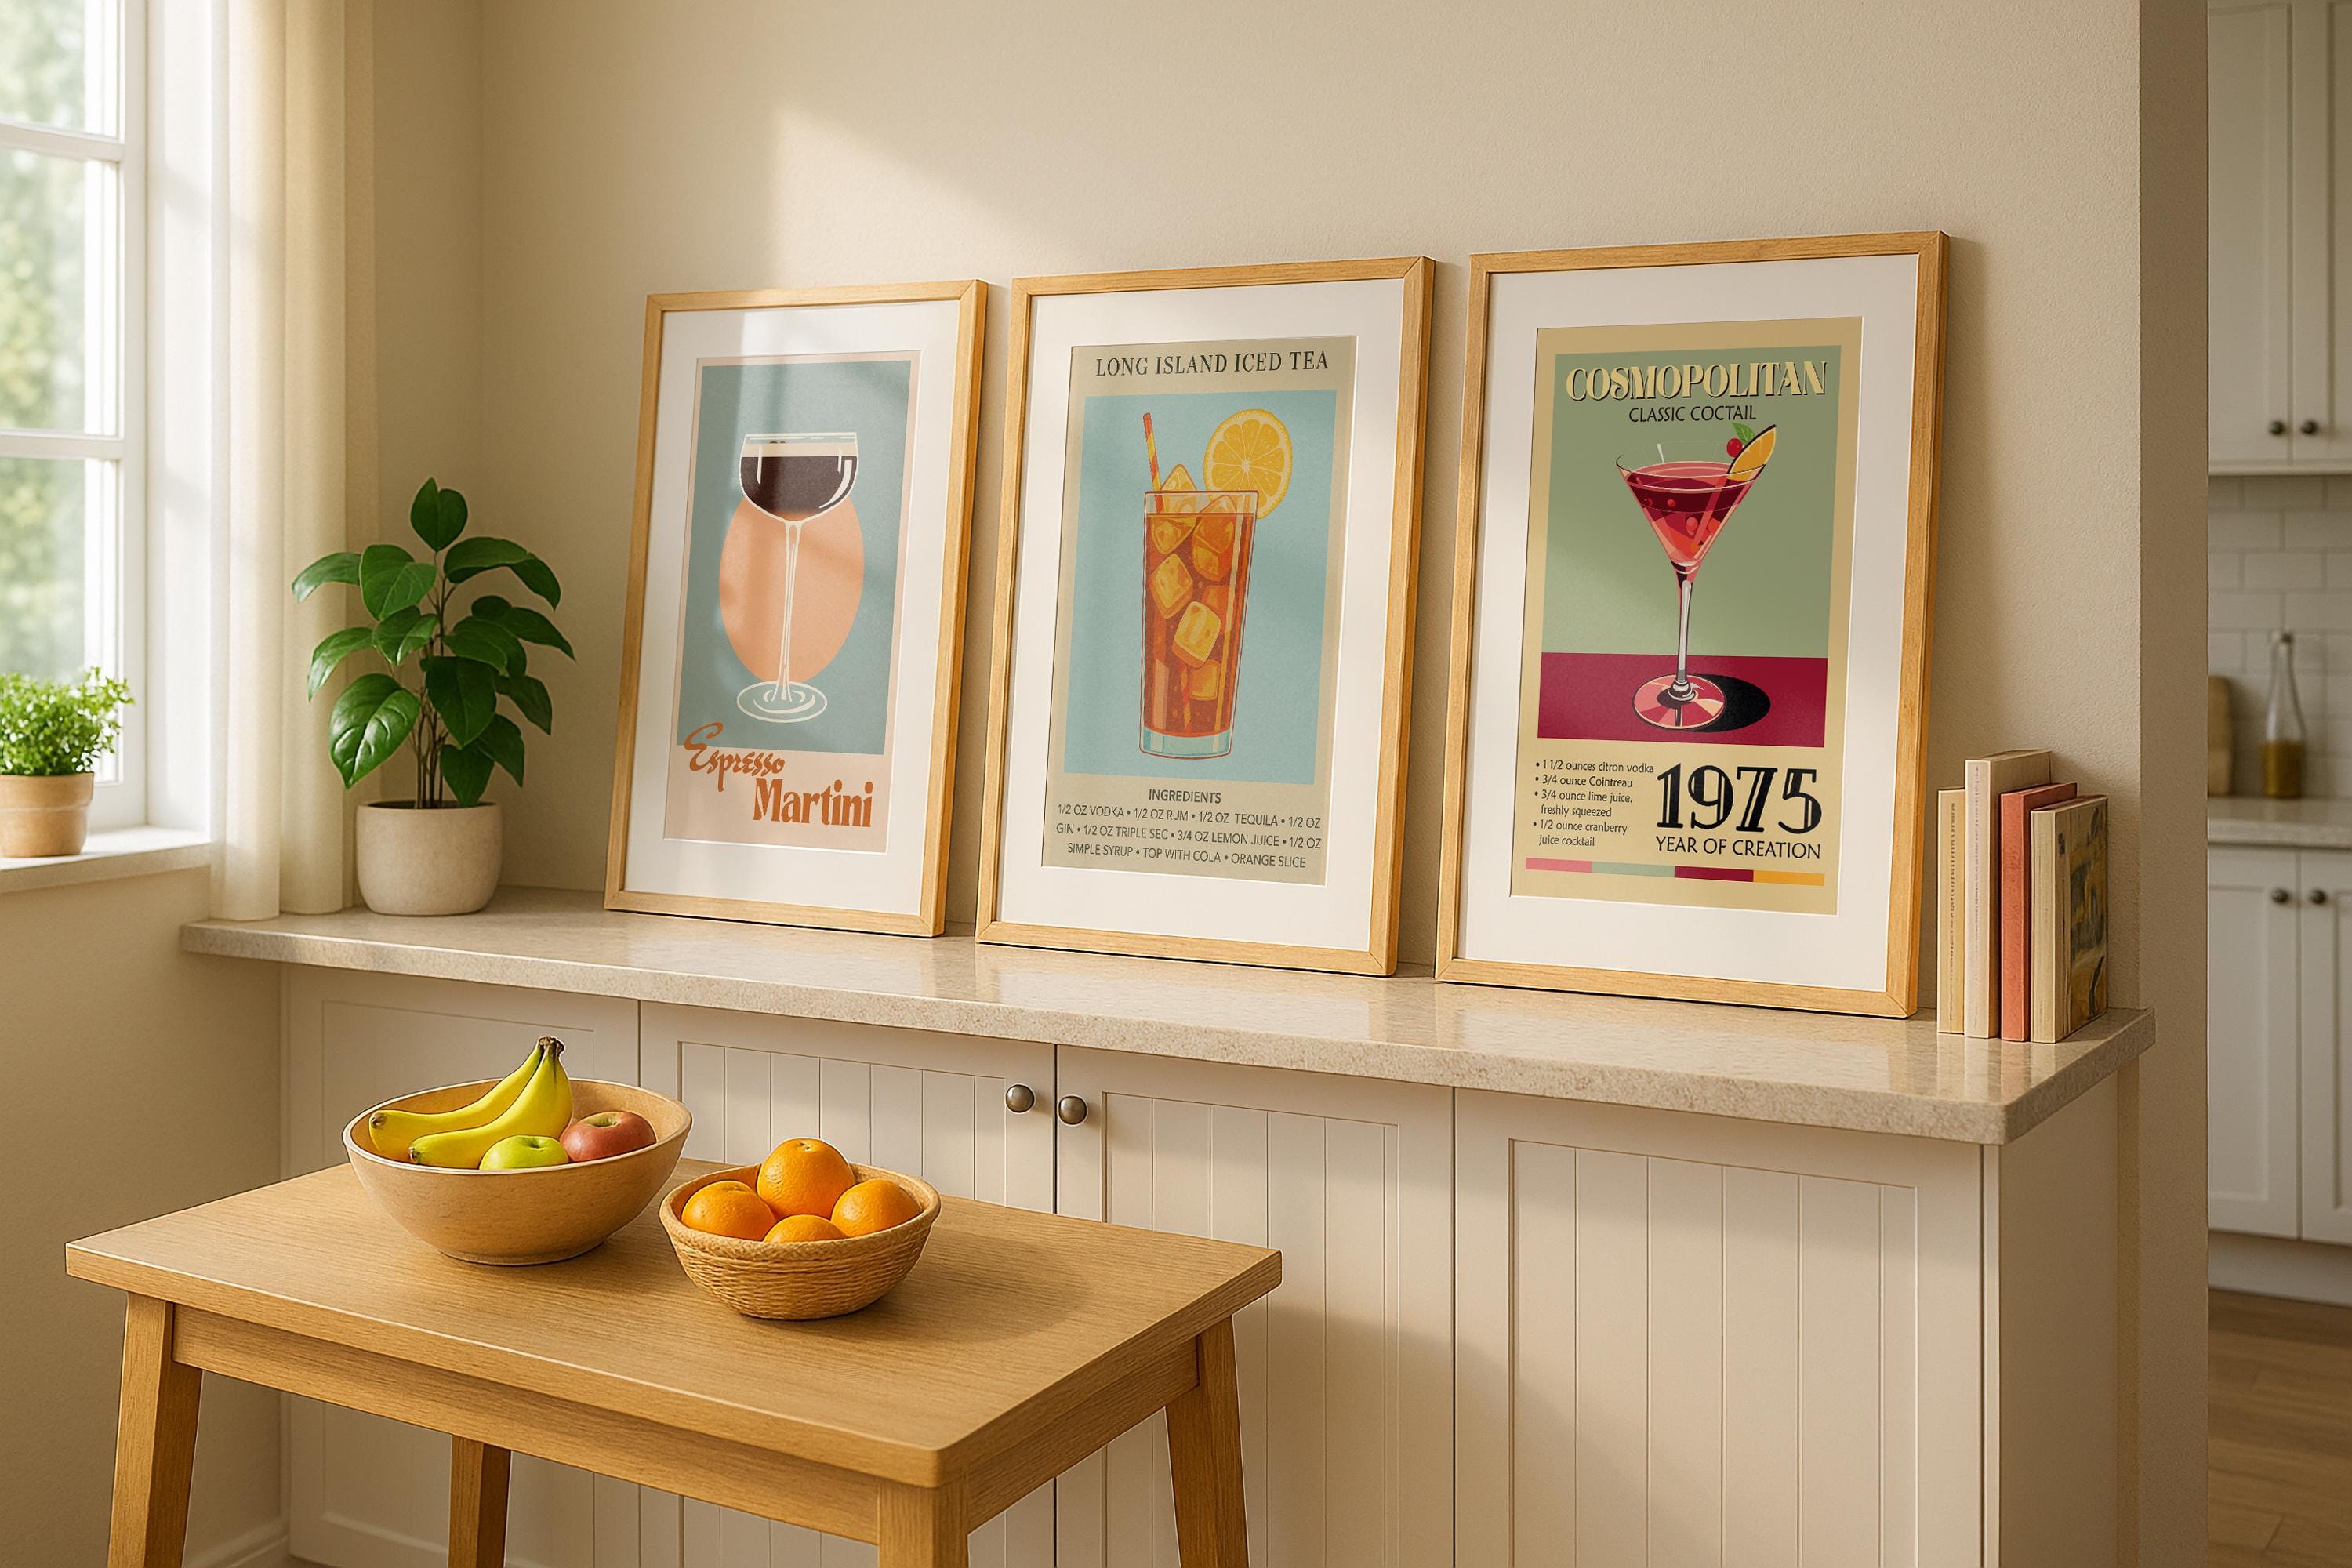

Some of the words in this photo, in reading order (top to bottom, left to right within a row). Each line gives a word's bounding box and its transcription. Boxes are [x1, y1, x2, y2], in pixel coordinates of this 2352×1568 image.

[1095, 357, 1148, 376] LONG
[1155, 354, 1227, 375] ISLAND
[1234, 352, 1282, 372] ICED
[1290, 350, 1329, 371] TEA
[1566, 360, 1827, 401] COSMOPOLITAN
[1628, 406, 1686, 423] CLASSIC
[1690, 405, 1756, 421] COCTAIL
[684, 721, 786, 792] Espresso
[1543, 760, 1547, 769] 1
[1550, 760, 1563, 770] 1/2
[1566, 762, 1595, 771] ounces
[1599, 762, 1624, 772] citron
[1627, 763, 1654, 773] vodka
[1542, 774, 1557, 784] 3/4
[1559, 777, 1586, 786] ounce
[1588, 775, 1632, 788] Cointreau
[753, 777, 873, 827] Martini
[1149, 789, 1221, 804] INGREDIENTS
[1541, 789, 1556, 800] 3/4
[1559, 792, 1586, 800] ounce
[1588, 791, 1607, 802] lime
[1609, 793, 1633, 804] juice,
[1657, 763, 1822, 833] 1975
[1058, 804, 1071, 815] 1/2
[1073, 804, 1087, 815] OZ
[1090, 805, 1124, 817] VODKA
[1134, 808, 1148, 818] 1/2
[1150, 808, 1164, 820] OZ
[1167, 810, 1189, 821] RUM
[1199, 811, 1213, 822] 1/2
[1215, 812, 1229, 823] OZ
[1235, 813, 1278, 826] TEQUILA
[1289, 816, 1303, 828] 1/2
[1306, 817, 1321, 829] OZ
[1541, 804, 1569, 817] freshly
[1572, 807, 1612, 818] squeezed
[1056, 822, 1074, 834] GIN
[1083, 825, 1097, 836] 1/2
[1099, 826, 1113, 837] OZ
[1116, 826, 1147, 838] TRIPLE
[1149, 828, 1168, 840] SEC
[1178, 829, 1192, 841] 3/4
[1195, 831, 1209, 842] OZ
[1211, 832, 1248, 844] LEMON
[1251, 834, 1279, 846] JUICE
[1289, 837, 1303, 848] 1/2
[1306, 837, 1322, 849] OZ
[1541, 819, 1553, 829] 1/2
[1555, 822, 1582, 831] ounce
[1585, 822, 1628, 835] cranberry
[1539, 834, 1559, 846] juice
[1562, 836, 1595, 847] cocktail
[1656, 835, 1698, 853] YEAR
[1703, 837, 1727, 855] OF
[1733, 839, 1820, 859] CREATION
[1067, 842, 1101, 855] SIMPLE
[1102, 844, 1134, 857] SYRUP
[1142, 847, 1163, 858] TOP
[1165, 849, 1191, 861] WITH
[1193, 850, 1221, 862] COLA
[1231, 852, 1276, 866] ORANGE
[1278, 855, 1306, 868] SLICE
